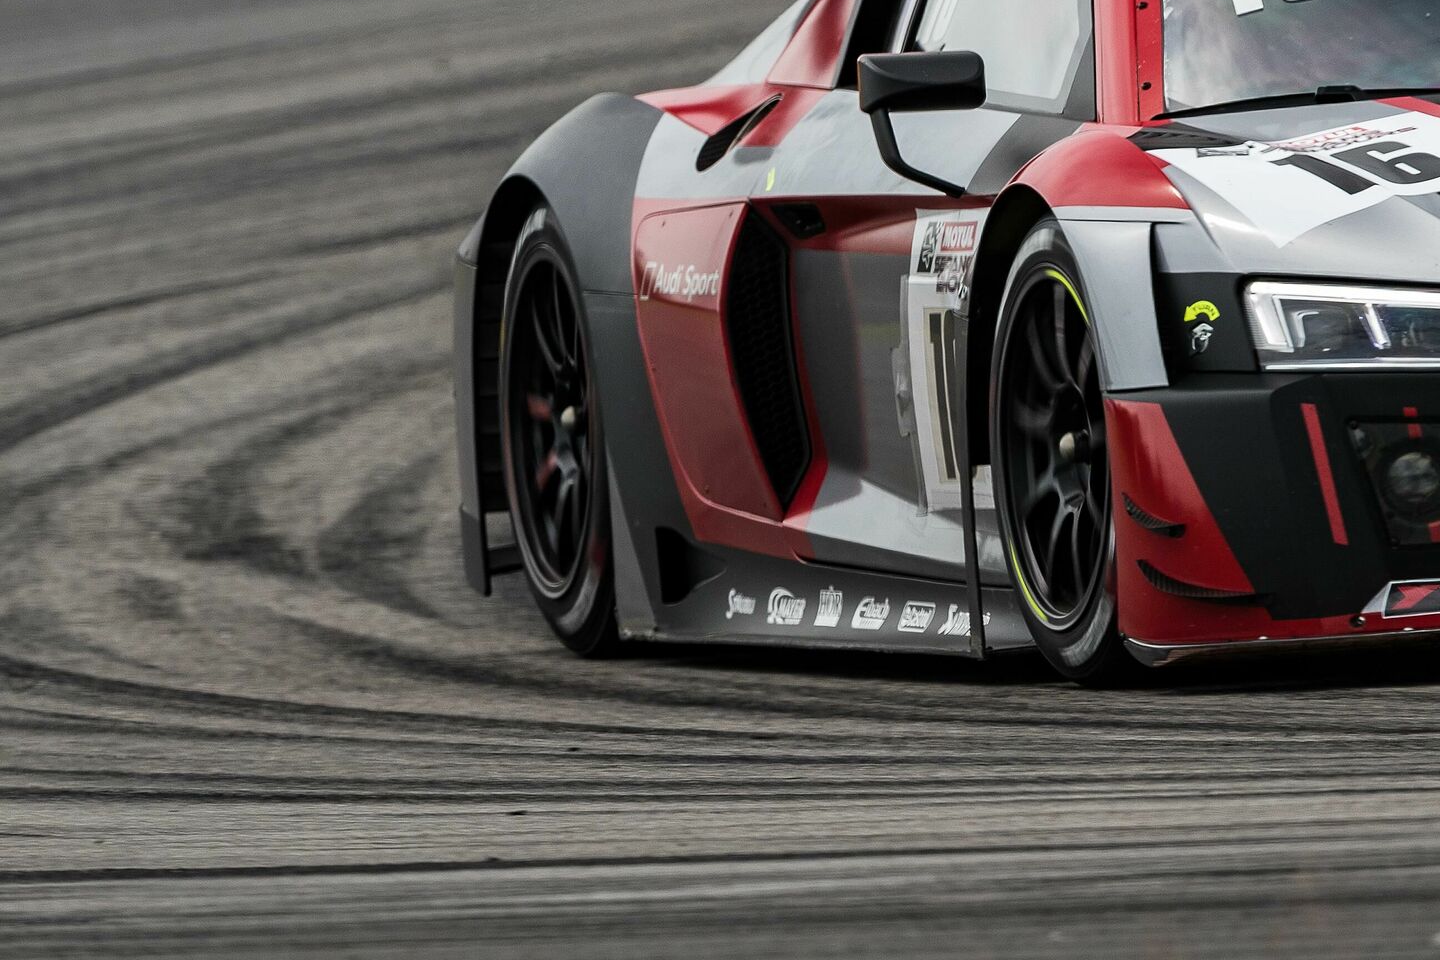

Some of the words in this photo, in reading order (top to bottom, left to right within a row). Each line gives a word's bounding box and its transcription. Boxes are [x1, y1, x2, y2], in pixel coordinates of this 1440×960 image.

[943, 225, 975, 249] MOTUL
[653, 264, 684, 295] Audi
[682, 264, 720, 303] Sport
